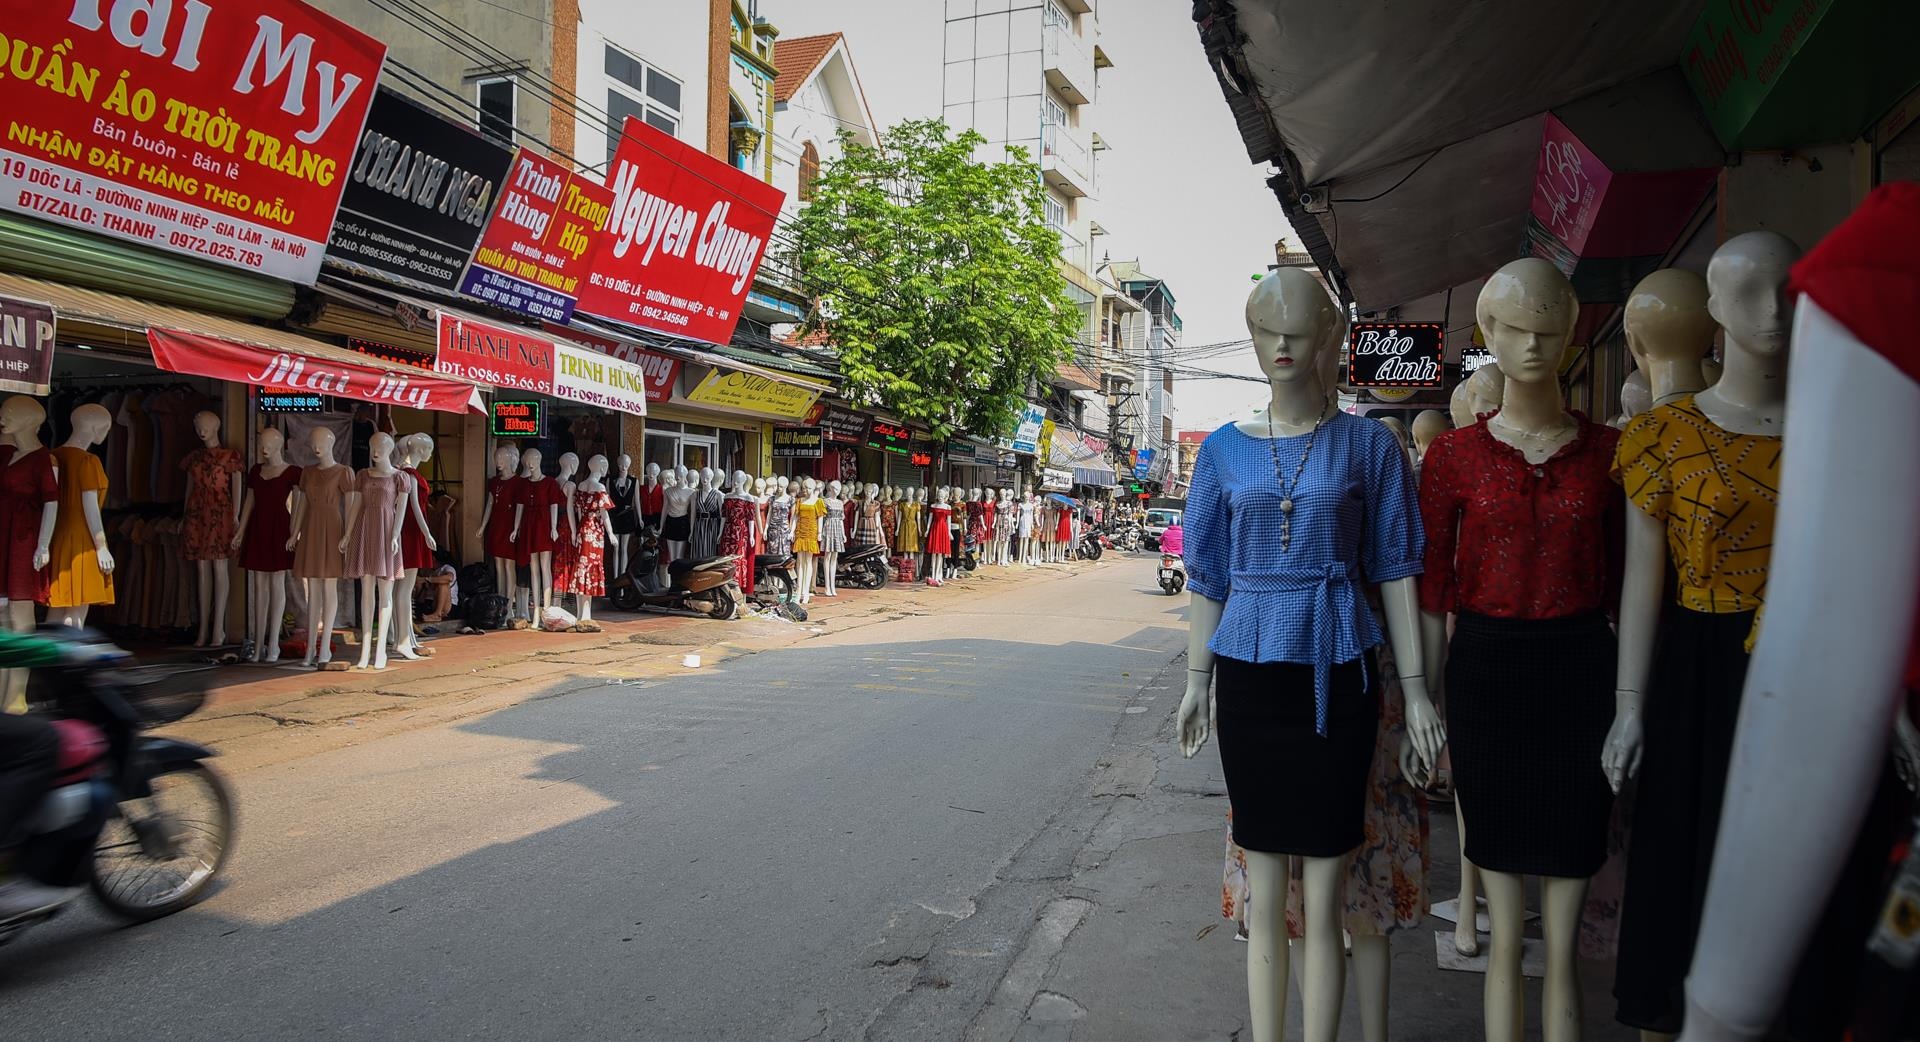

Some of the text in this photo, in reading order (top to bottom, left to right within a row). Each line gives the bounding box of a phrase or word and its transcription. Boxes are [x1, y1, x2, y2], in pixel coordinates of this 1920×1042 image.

[233, 15, 362, 144] My
[93, 117, 240, 180] Bán buôn Bán lẻ
[102, 69, 156, 122] ÁO
[164, 98, 241, 153] THỜI
[245, 129, 337, 187] TRANG
[8, 121, 295, 226] NHẬN ĐẶT HÀNG THEO MẪU
[354, 129, 492, 227] THANH NGA
[514, 157, 562, 203] Trình
[1, 157, 25, 180] 19
[28, 160, 61, 190] DỐC
[63, 174, 82, 195] LÃ
[95, 186, 143, 212] ĐƯỜNG
[146, 201, 178, 223] NINH
[180, 211, 209, 237] HIỆP
[237, 224, 262, 246] LÂM
[271, 234, 286, 252] HÀ
[288, 241, 307, 259] NỘI
[18, 190, 263, 268] ĐT/ZALO: THANH 0972.025.783
[500, 192, 550, 240] Hùng
[564, 184, 609, 233] Trang
[603, 159, 761, 295] Nguyen Chung
[336, 238, 359, 253] ZALO:
[511, 241, 566, 269] BÁN BUÔN BÁN LẺ
[558, 222, 589, 260] Híp
[477, 247, 579, 293] QUẦN ÁO THỜI TRANG NỮ
[490, 273, 499, 286] 19
[590, 272, 730, 321] ĐC: 19 DỐC LÃ ĐƯỜNG NINH HIỆP GL HN
[629, 302, 690, 326] ĐT: 0942.345646
[447, 325, 510, 361] THANH
[517, 342, 551, 370] NGA
[1356, 329, 1414, 355] Bảo
[6, 360, 29, 374] HIỆP
[248, 354, 352, 393] Mai
[363, 372, 432, 409] My
[441, 361, 551, 393] ĐT: 0986.55.66.95
[1375, 356, 1437, 381] Anh
[557, 384, 577, 399] ĐT:
[579, 390, 642, 413] 0987.186.306
